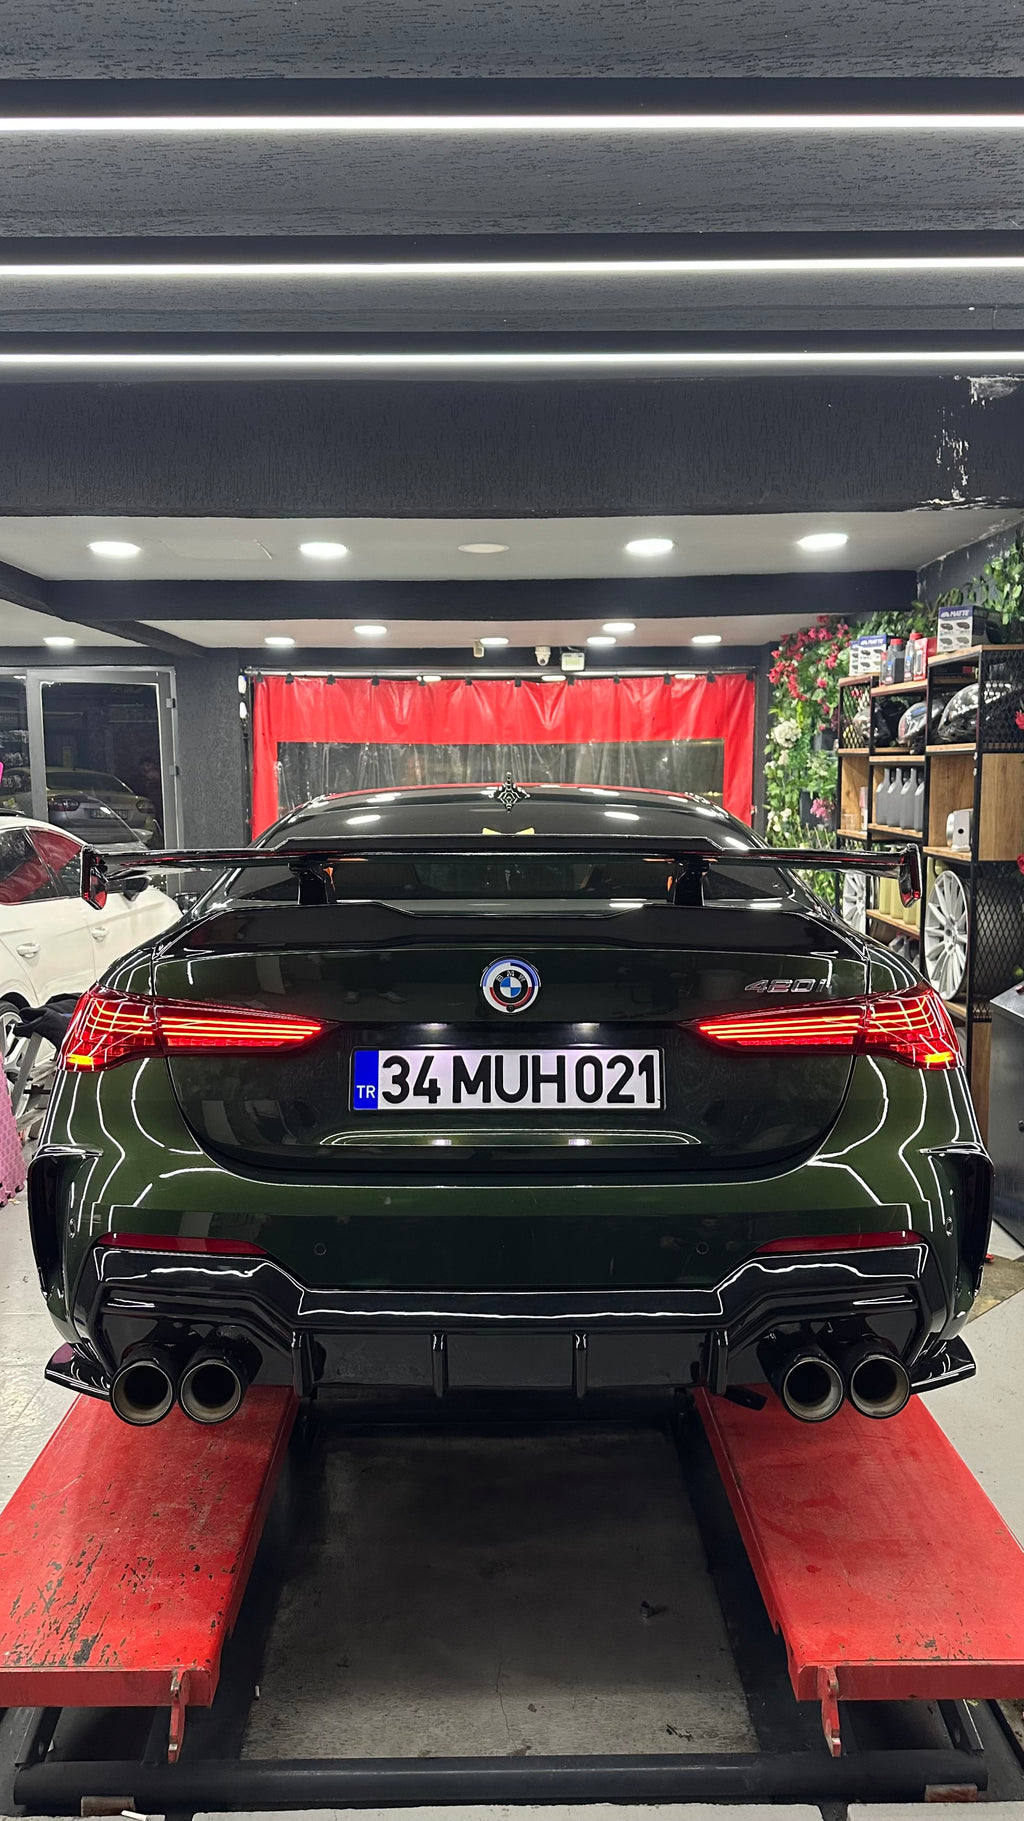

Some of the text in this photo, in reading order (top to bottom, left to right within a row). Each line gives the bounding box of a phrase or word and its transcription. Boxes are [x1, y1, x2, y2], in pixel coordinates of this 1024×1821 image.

[950, 609, 970, 617] MATTE
[495, 970, 526, 982] BMW
[744, 979, 827, 993] 420i
[381, 1054, 655, 1104] 34 MUH 021
[356, 1084, 376, 1099] TR
